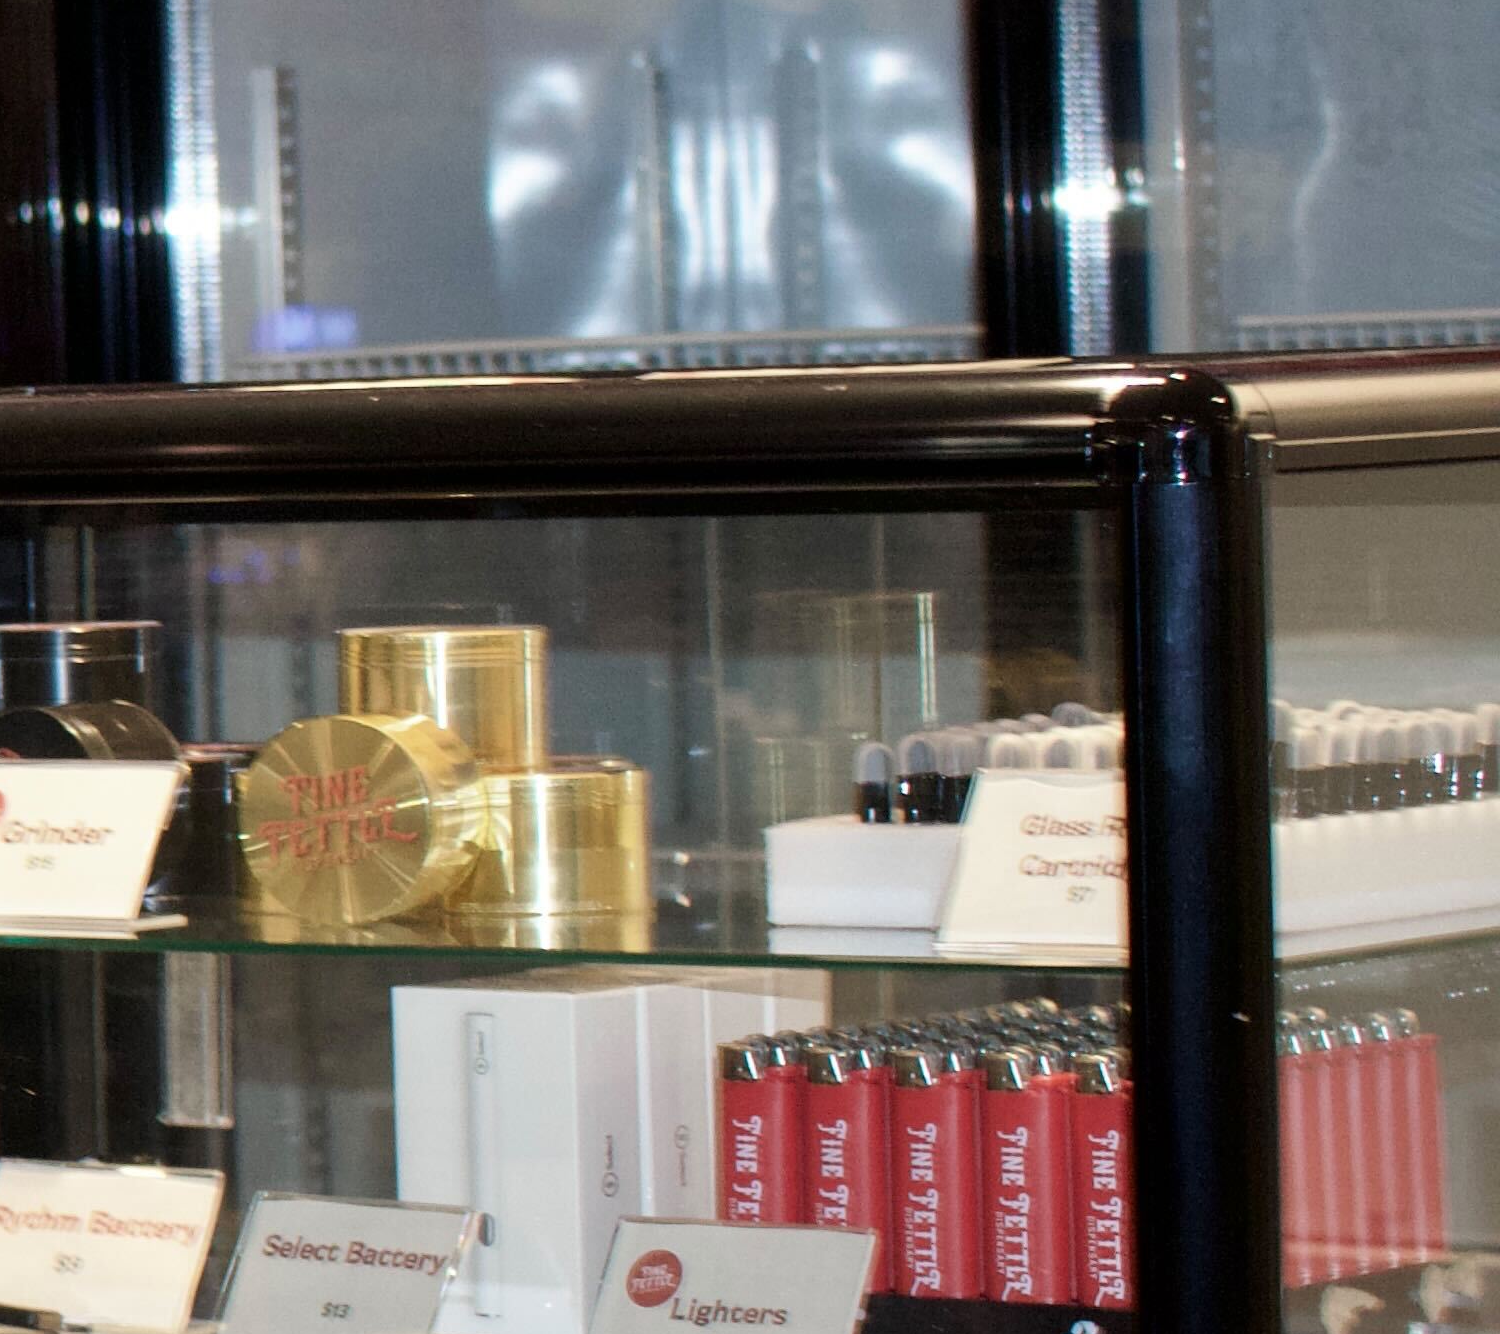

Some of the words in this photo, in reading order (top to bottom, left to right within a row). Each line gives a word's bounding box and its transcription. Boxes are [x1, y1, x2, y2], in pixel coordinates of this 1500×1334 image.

[3, 820, 115, 845] Grinder
[87, 1210, 200, 1247] Battery
[261, 1234, 340, 1262] Select
[345, 1240, 449, 1276] Battery
[320, 1302, 350, 1318] $13
[668, 1298, 789, 1327] Lighters
